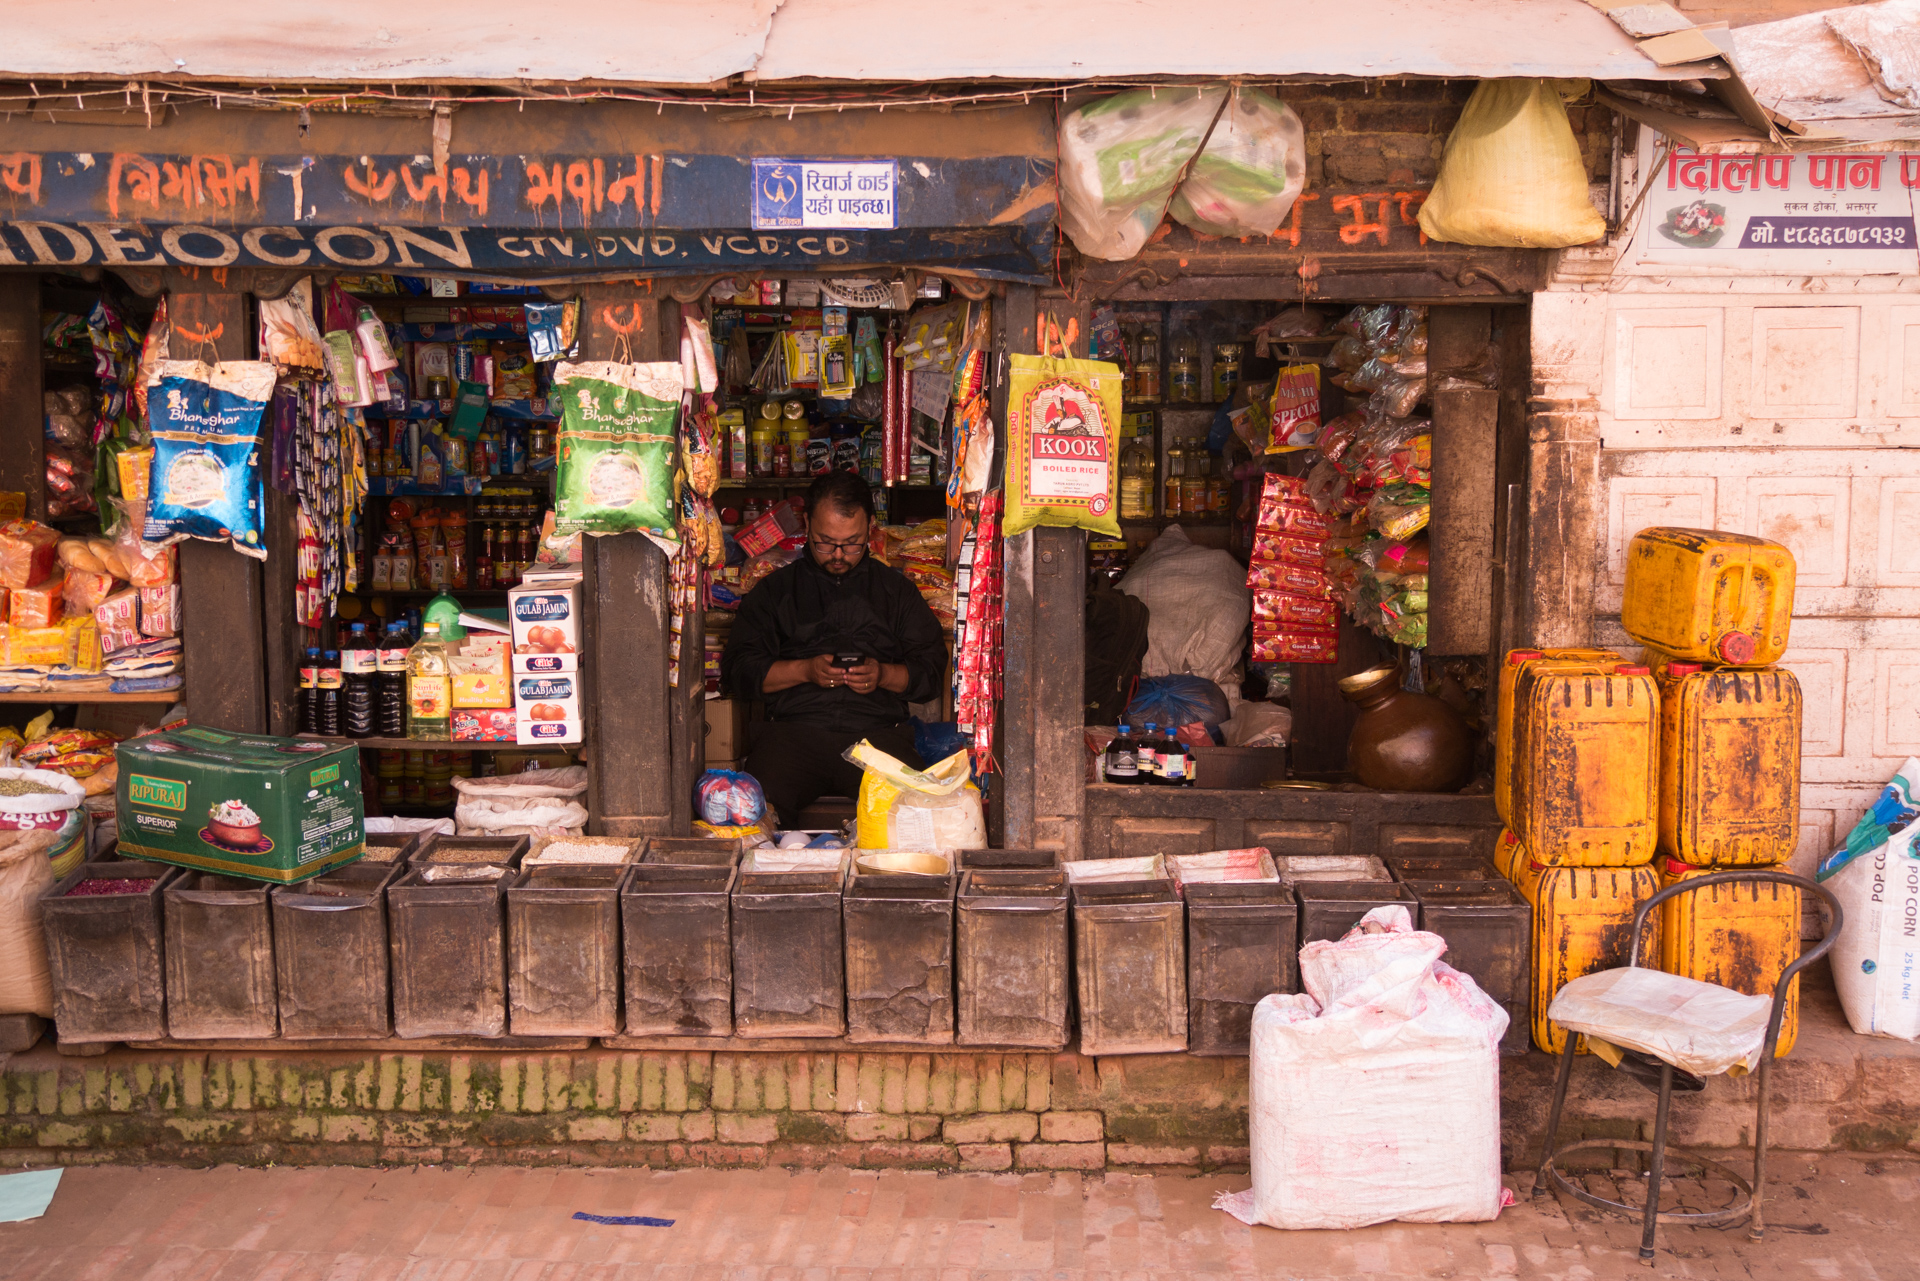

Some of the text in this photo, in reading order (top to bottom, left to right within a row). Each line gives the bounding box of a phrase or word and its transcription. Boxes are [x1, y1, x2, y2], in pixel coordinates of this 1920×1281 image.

[1808, 155, 1885, 190] पान
[807, 170, 891, 192] रिचार्ज कार्ड
[806, 193, 833, 216] यहाँ
[1784, 202, 1808, 214] सुकल
[1751, 222, 1777, 243] मो.
[797, 236, 850, 256] CD
[1039, 437, 1103, 457] KOOK
[1042, 465, 1100, 475] BOILED RICE
[516, 602, 569, 616] GULAB JAMUN
[534, 656, 554, 668] Gits
[520, 685, 572, 697] GULAB JAMUN
[458, 696, 484, 705] Healthy
[539, 723, 559, 735] Gits
[137, 814, 178, 829] SUPERIOR
[1872, 873, 1885, 902] POP
[1904, 865, 1919, 937] POP CORN
[1904, 952, 1913, 964] 25
[1902, 982, 1911, 1000] Net
